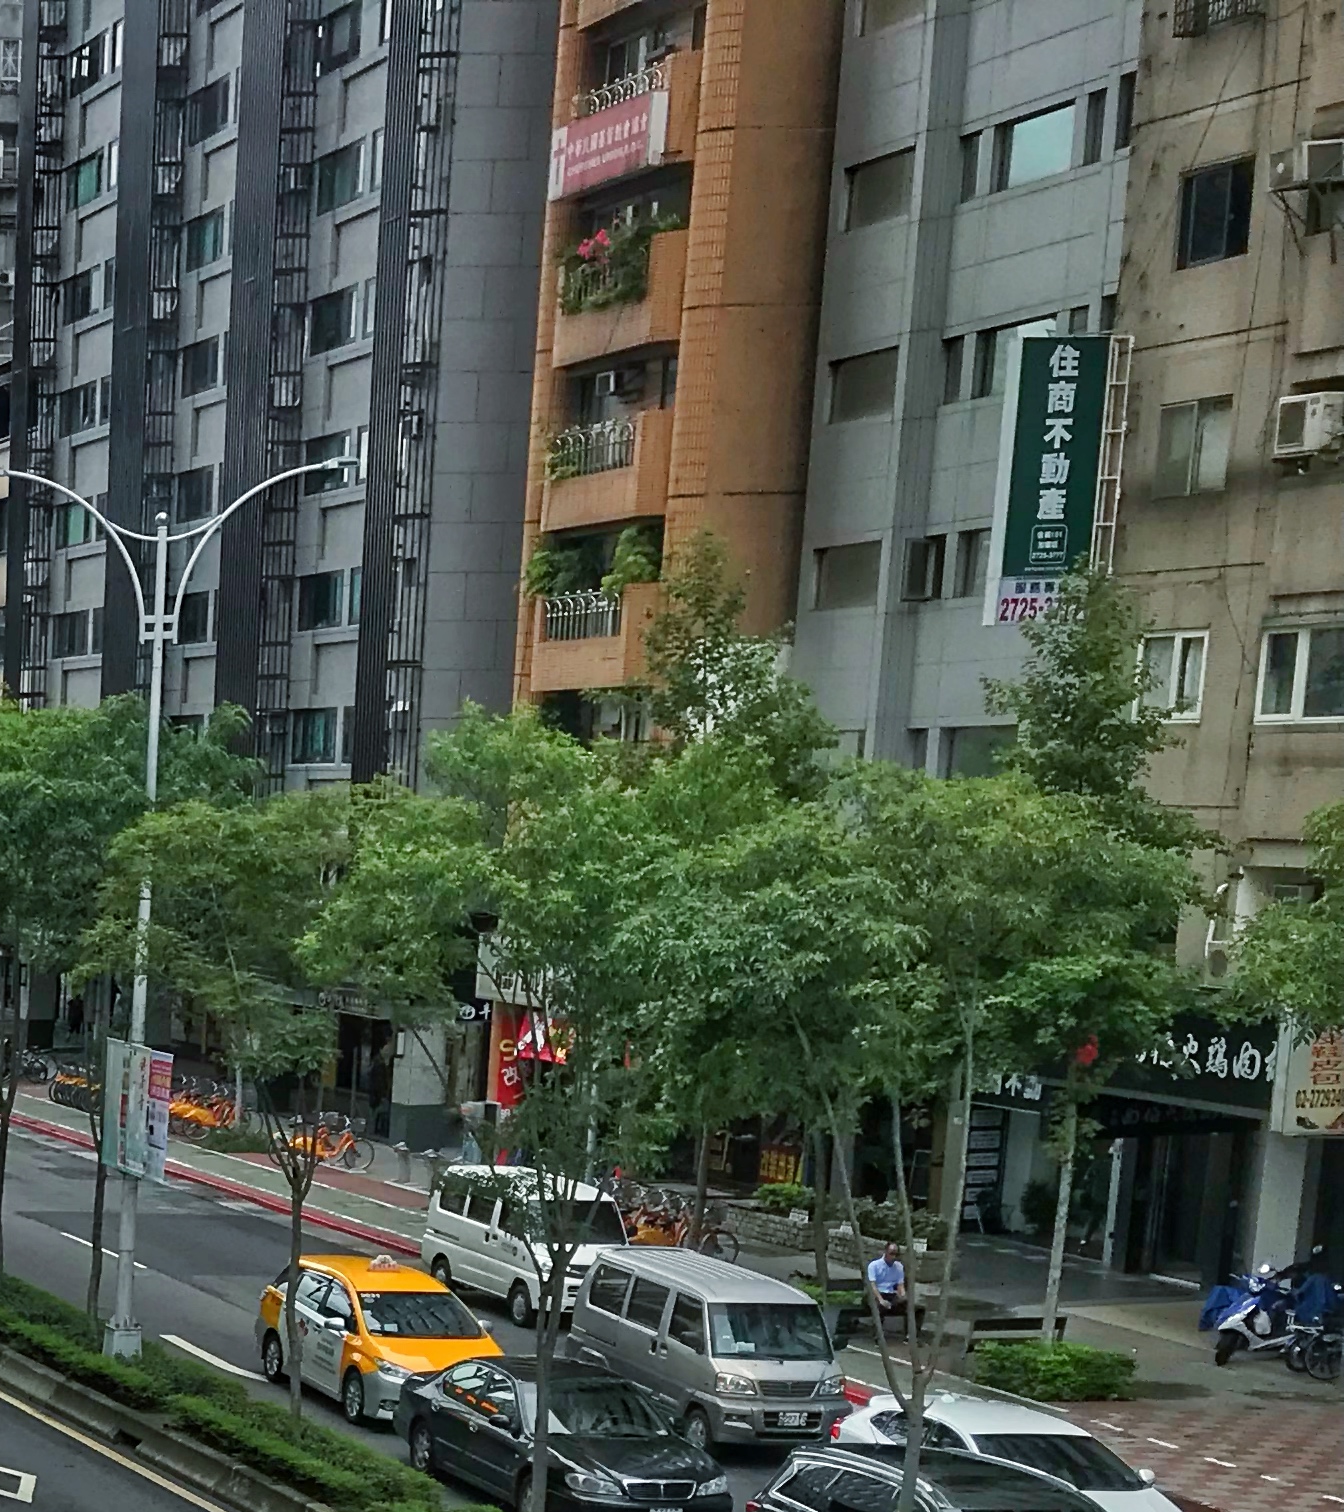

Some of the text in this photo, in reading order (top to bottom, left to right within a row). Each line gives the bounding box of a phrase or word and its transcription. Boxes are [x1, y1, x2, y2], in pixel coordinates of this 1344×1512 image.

[1036, 344, 1081, 520] 住商不動產
